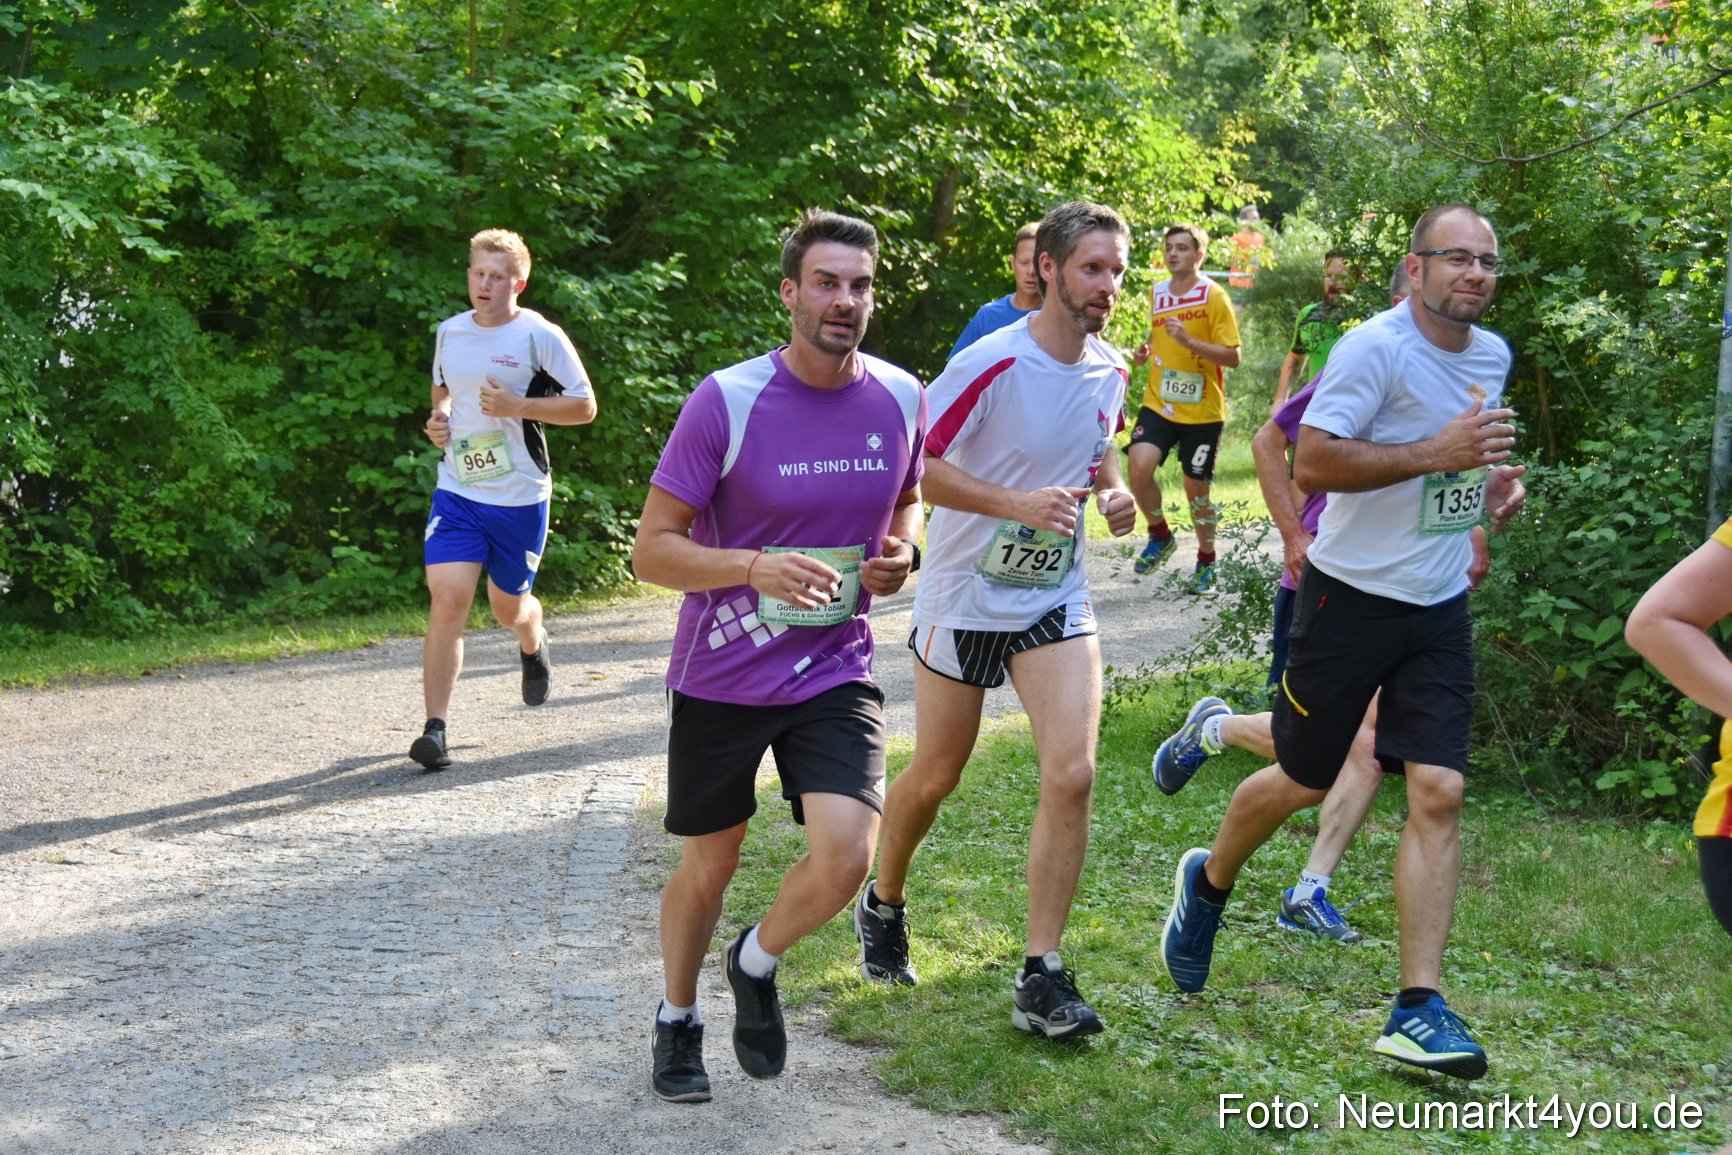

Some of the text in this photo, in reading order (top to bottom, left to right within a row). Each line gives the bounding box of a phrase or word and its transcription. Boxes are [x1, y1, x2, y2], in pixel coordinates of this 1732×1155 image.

[1178, 309, 1208, 322] BÖGL
[1165, 380, 1197, 395] 1629
[464, 450, 497, 471] 964
[1191, 444, 1210, 467] 6
[778, 458, 889, 476] WIR SIND LILA.
[1433, 484, 1483, 514] 1355
[1001, 543, 1062, 571] 1792
[1007, 567, 1029, 577] Zeiser
[823, 603, 846, 612] Tobias
